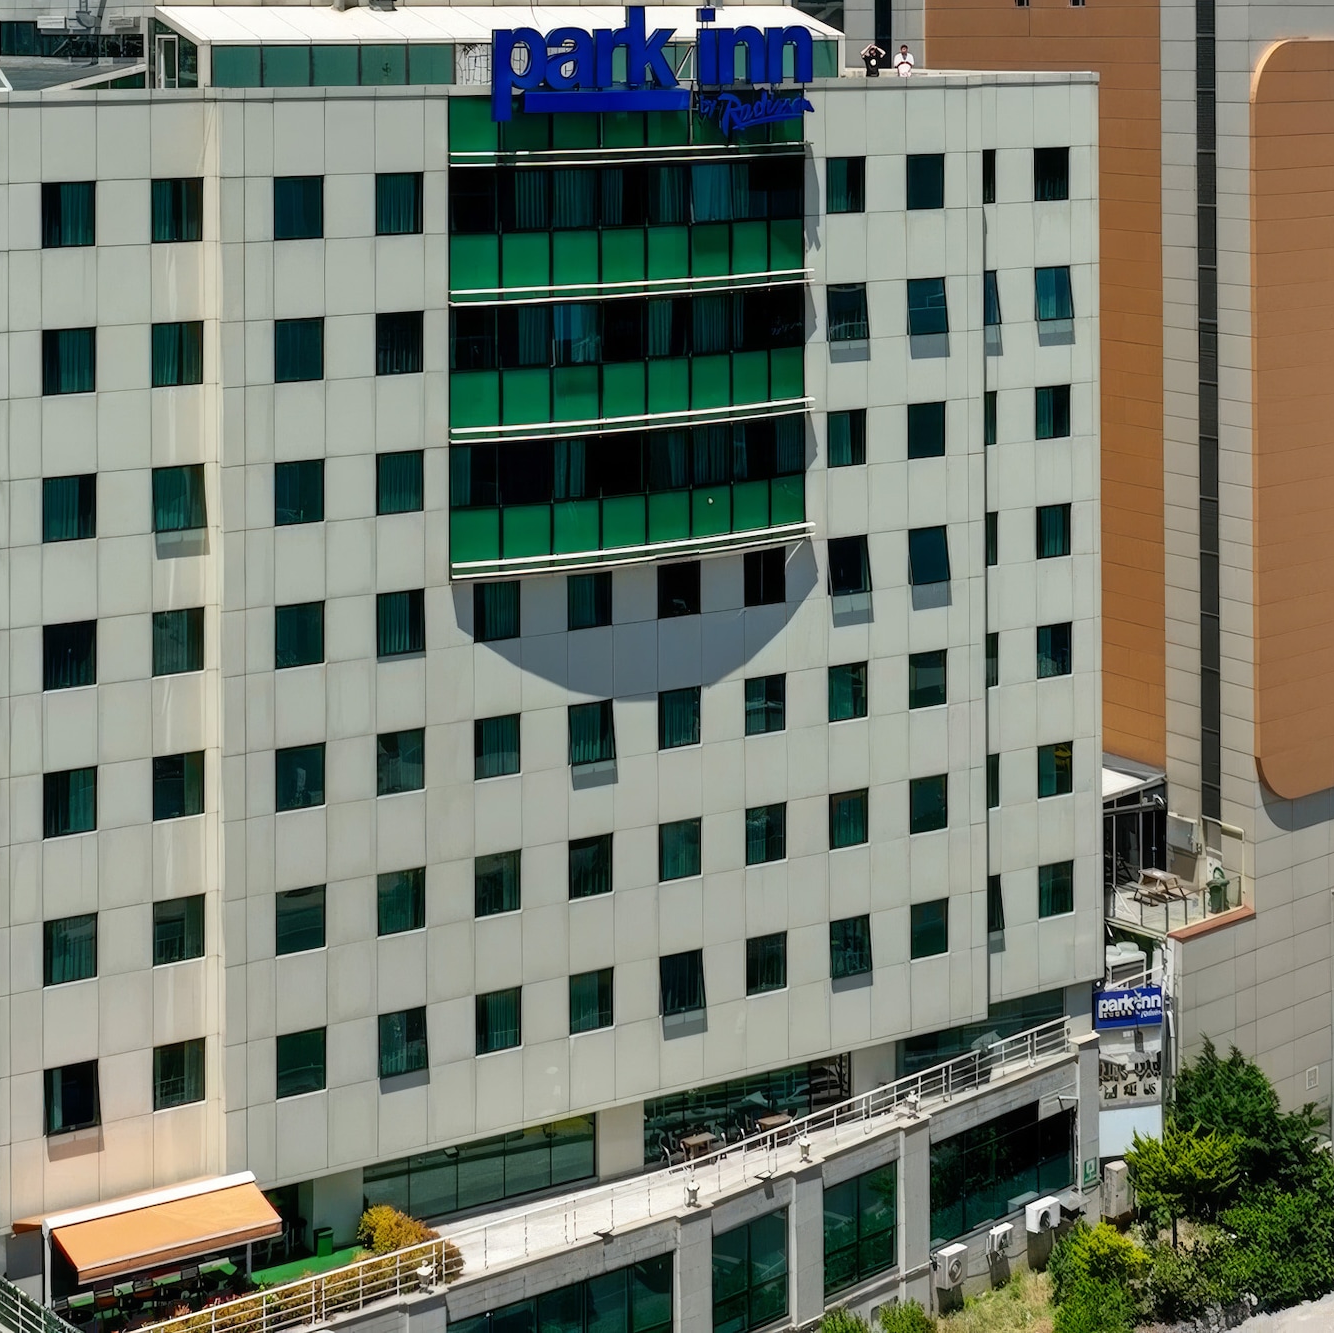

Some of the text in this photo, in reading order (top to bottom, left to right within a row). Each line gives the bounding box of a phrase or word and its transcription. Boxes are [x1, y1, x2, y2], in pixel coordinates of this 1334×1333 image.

[491, 6, 813, 122] park inn
[1098, 994, 1134, 1018] park
